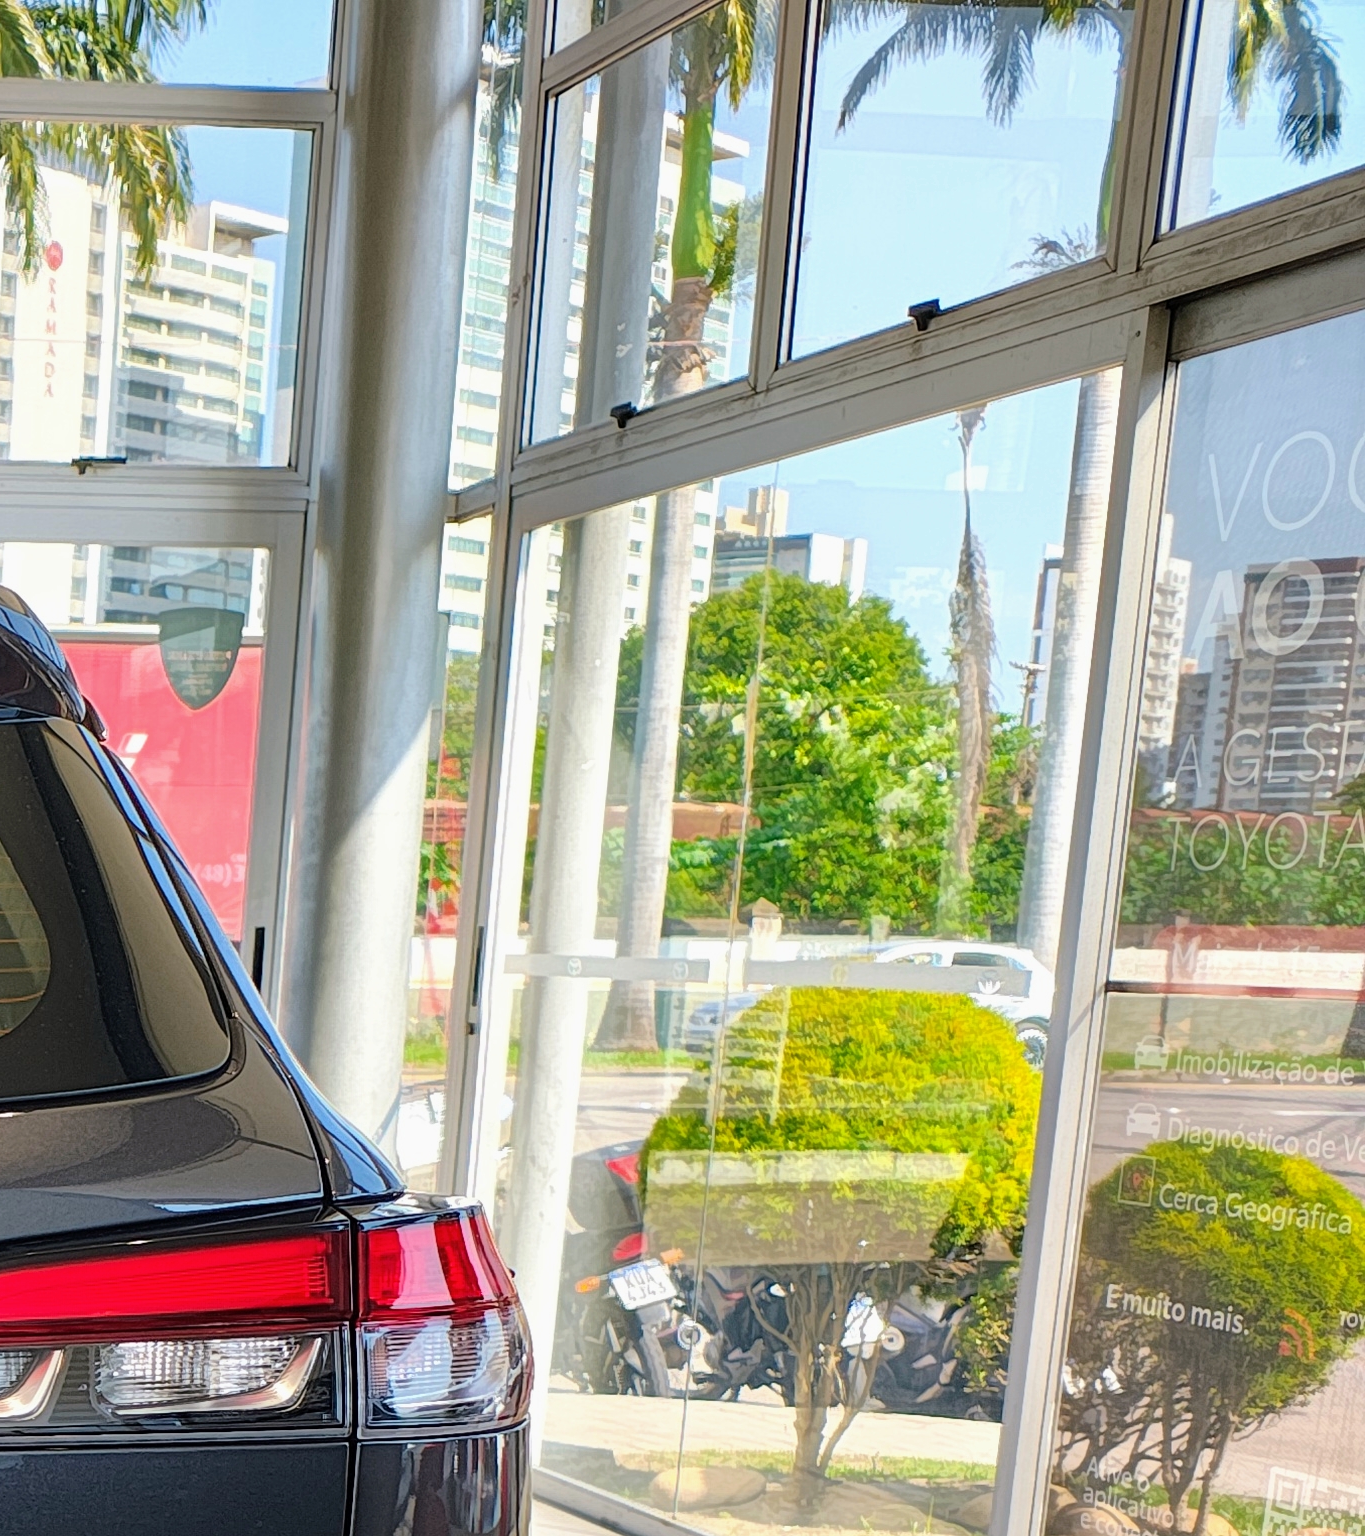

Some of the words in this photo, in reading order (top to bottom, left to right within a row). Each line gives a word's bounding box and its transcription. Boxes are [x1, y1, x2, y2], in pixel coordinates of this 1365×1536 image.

[43, 276, 58, 398] RAMADA
[1208, 430, 1365, 542] VO
[1173, 733, 1203, 788] A
[1223, 719, 1365, 786] GEST
[1175, 1049, 1318, 1086] Imobilização
[1323, 1058, 1355, 1086] de
[1166, 1117, 1300, 1157] Diagnóstico
[1305, 1131, 1337, 1160] de
[1159, 1184, 1219, 1216] Cerca
[1225, 1192, 1353, 1235] Geográfica
[1123, 1292, 1186, 1323] muito
[1190, 1306, 1250, 1336] mais.
[1080, 1512, 1092, 1529] e
[1082, 1485, 1175, 1529] aplicativo
